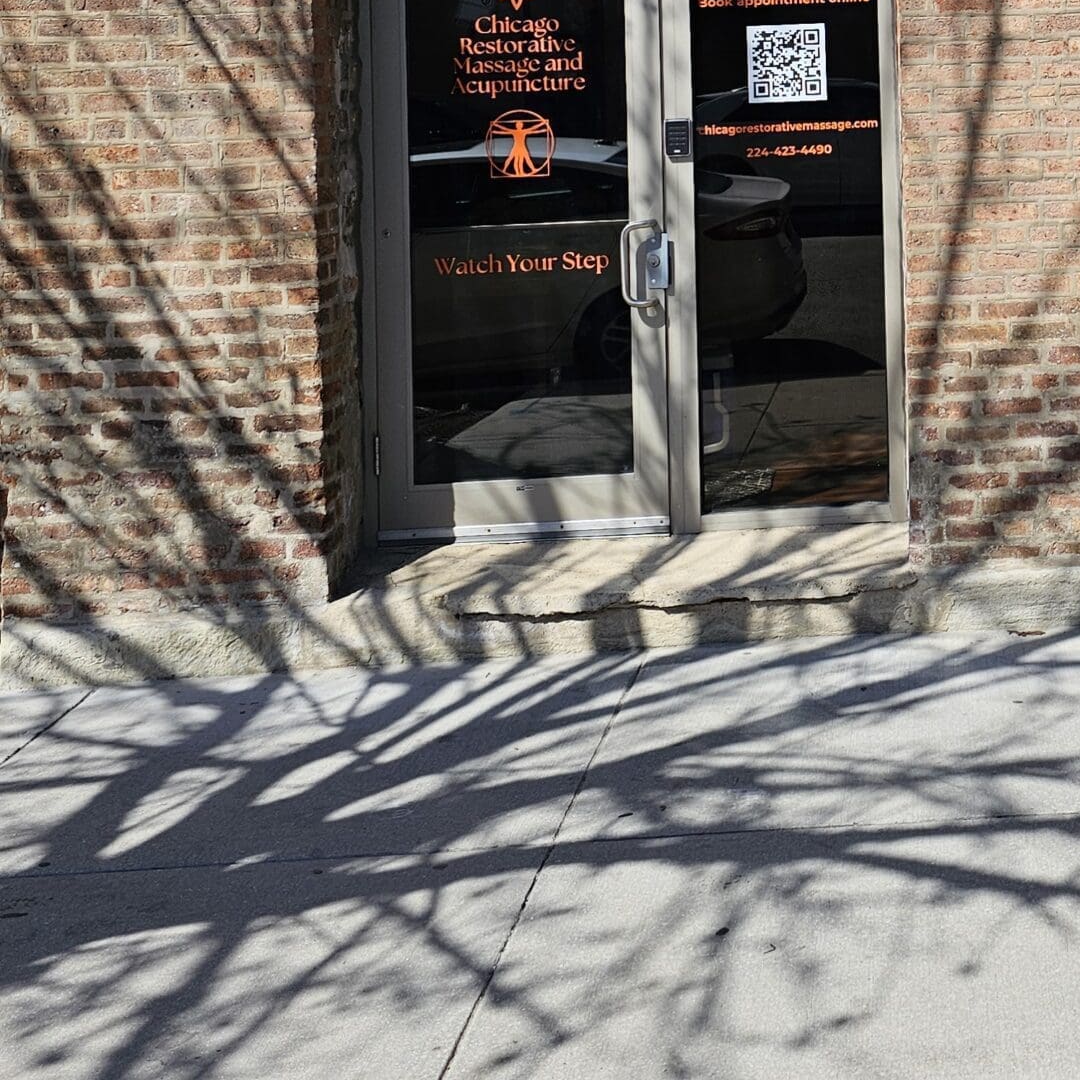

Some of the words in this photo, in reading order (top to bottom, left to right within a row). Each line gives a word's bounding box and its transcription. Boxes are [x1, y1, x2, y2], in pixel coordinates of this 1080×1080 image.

[474, 14, 560, 38] Chicago
[459, 36, 576, 56] Restorative
[453, 56, 541, 79] Massage
[544, 51, 583, 71] and
[450, 74, 586, 99] Acupuncture
[746, 143, 833, 158] 224-423-4490
[434, 253, 502, 276] Watch
[505, 252, 557, 273] Your
[561, 250, 609, 275] Step
